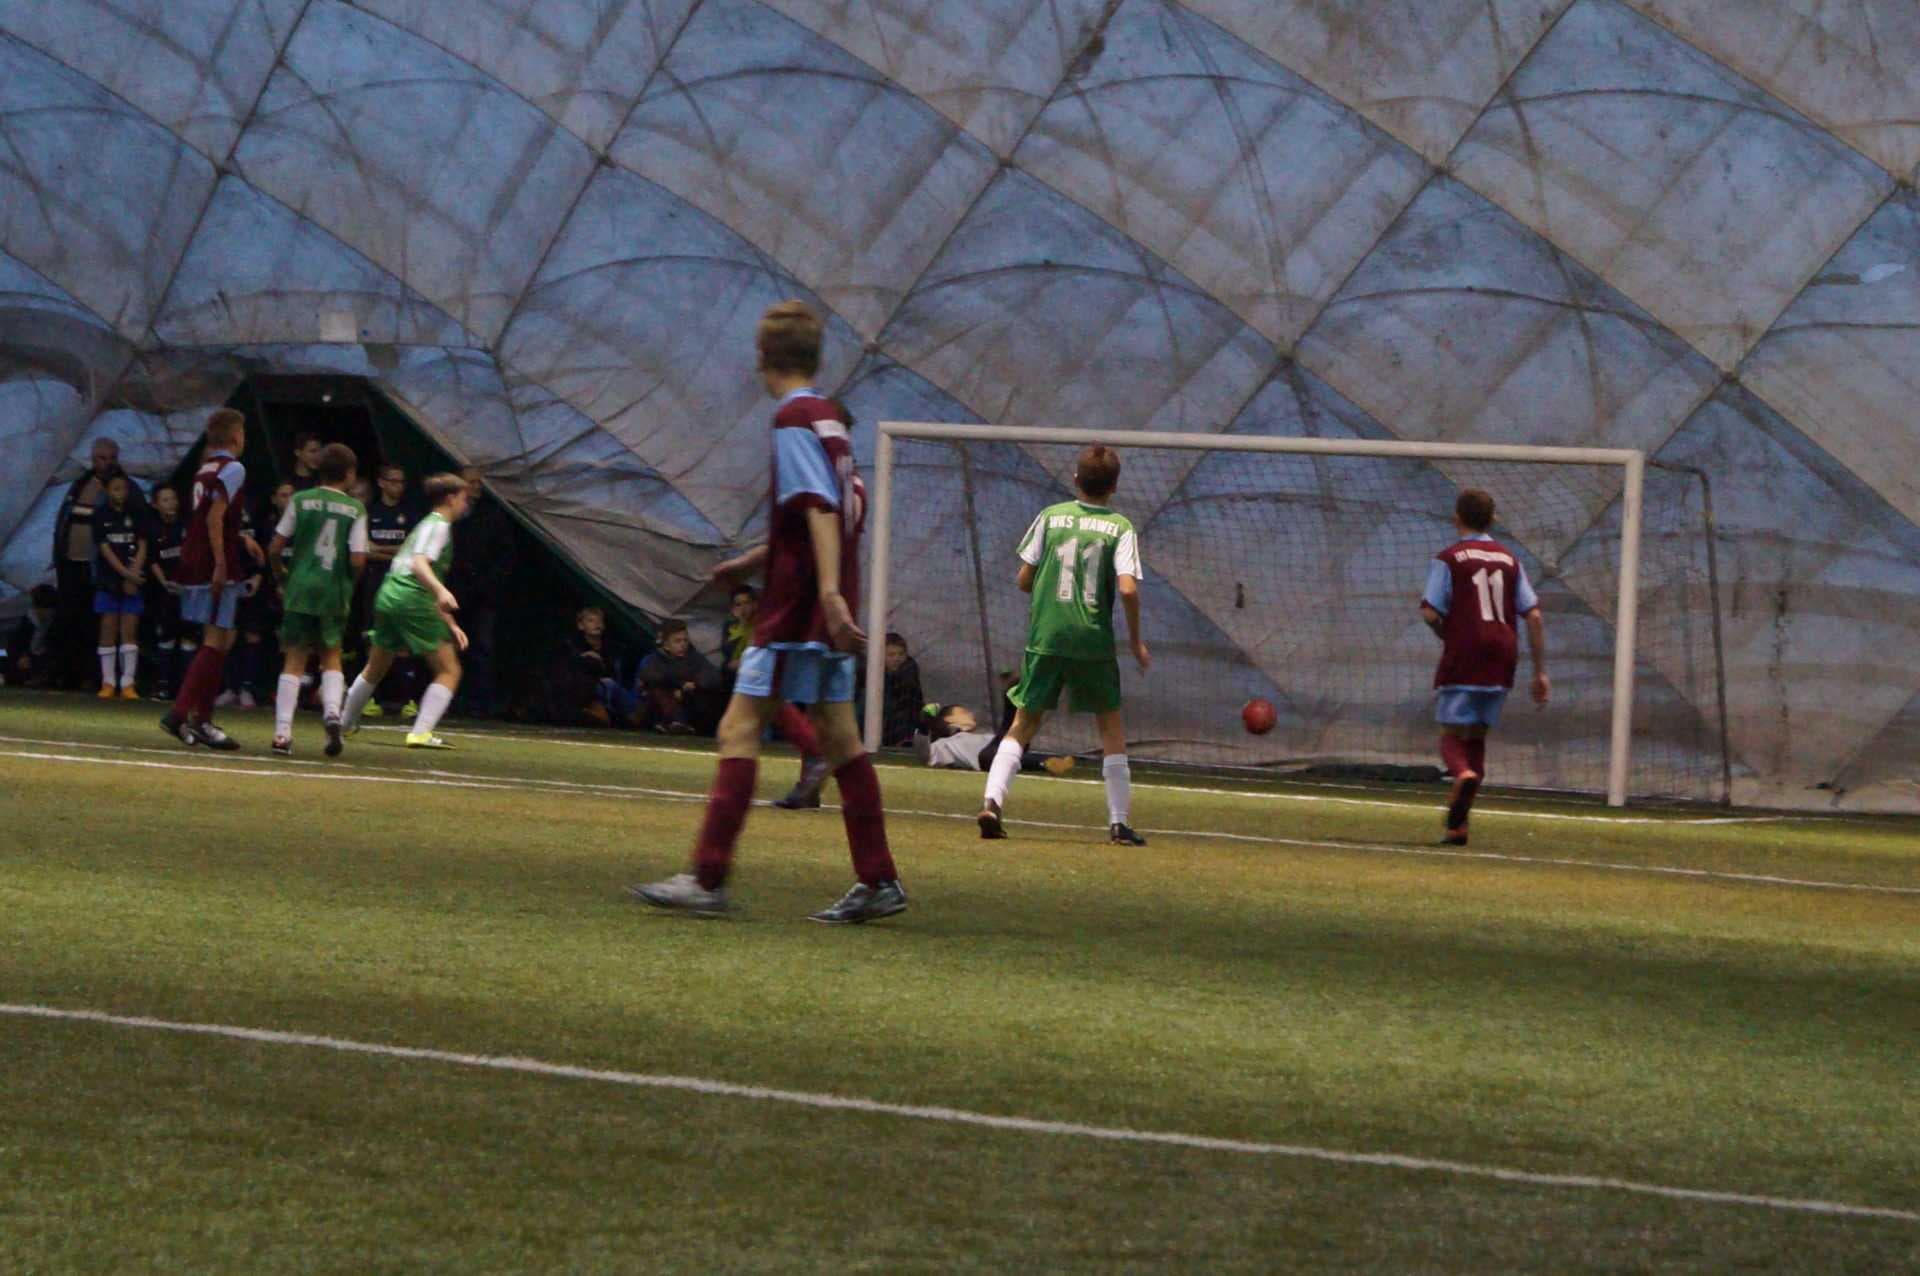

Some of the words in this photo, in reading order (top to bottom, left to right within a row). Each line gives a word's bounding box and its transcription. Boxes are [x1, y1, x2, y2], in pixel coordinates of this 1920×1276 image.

[314, 518, 338, 571] 4
[1048, 514, 1076, 529] WKS
[1079, 516, 1121, 538] WAWEL
[1057, 537, 1105, 607] 11
[1471, 567, 1506, 624] 11
